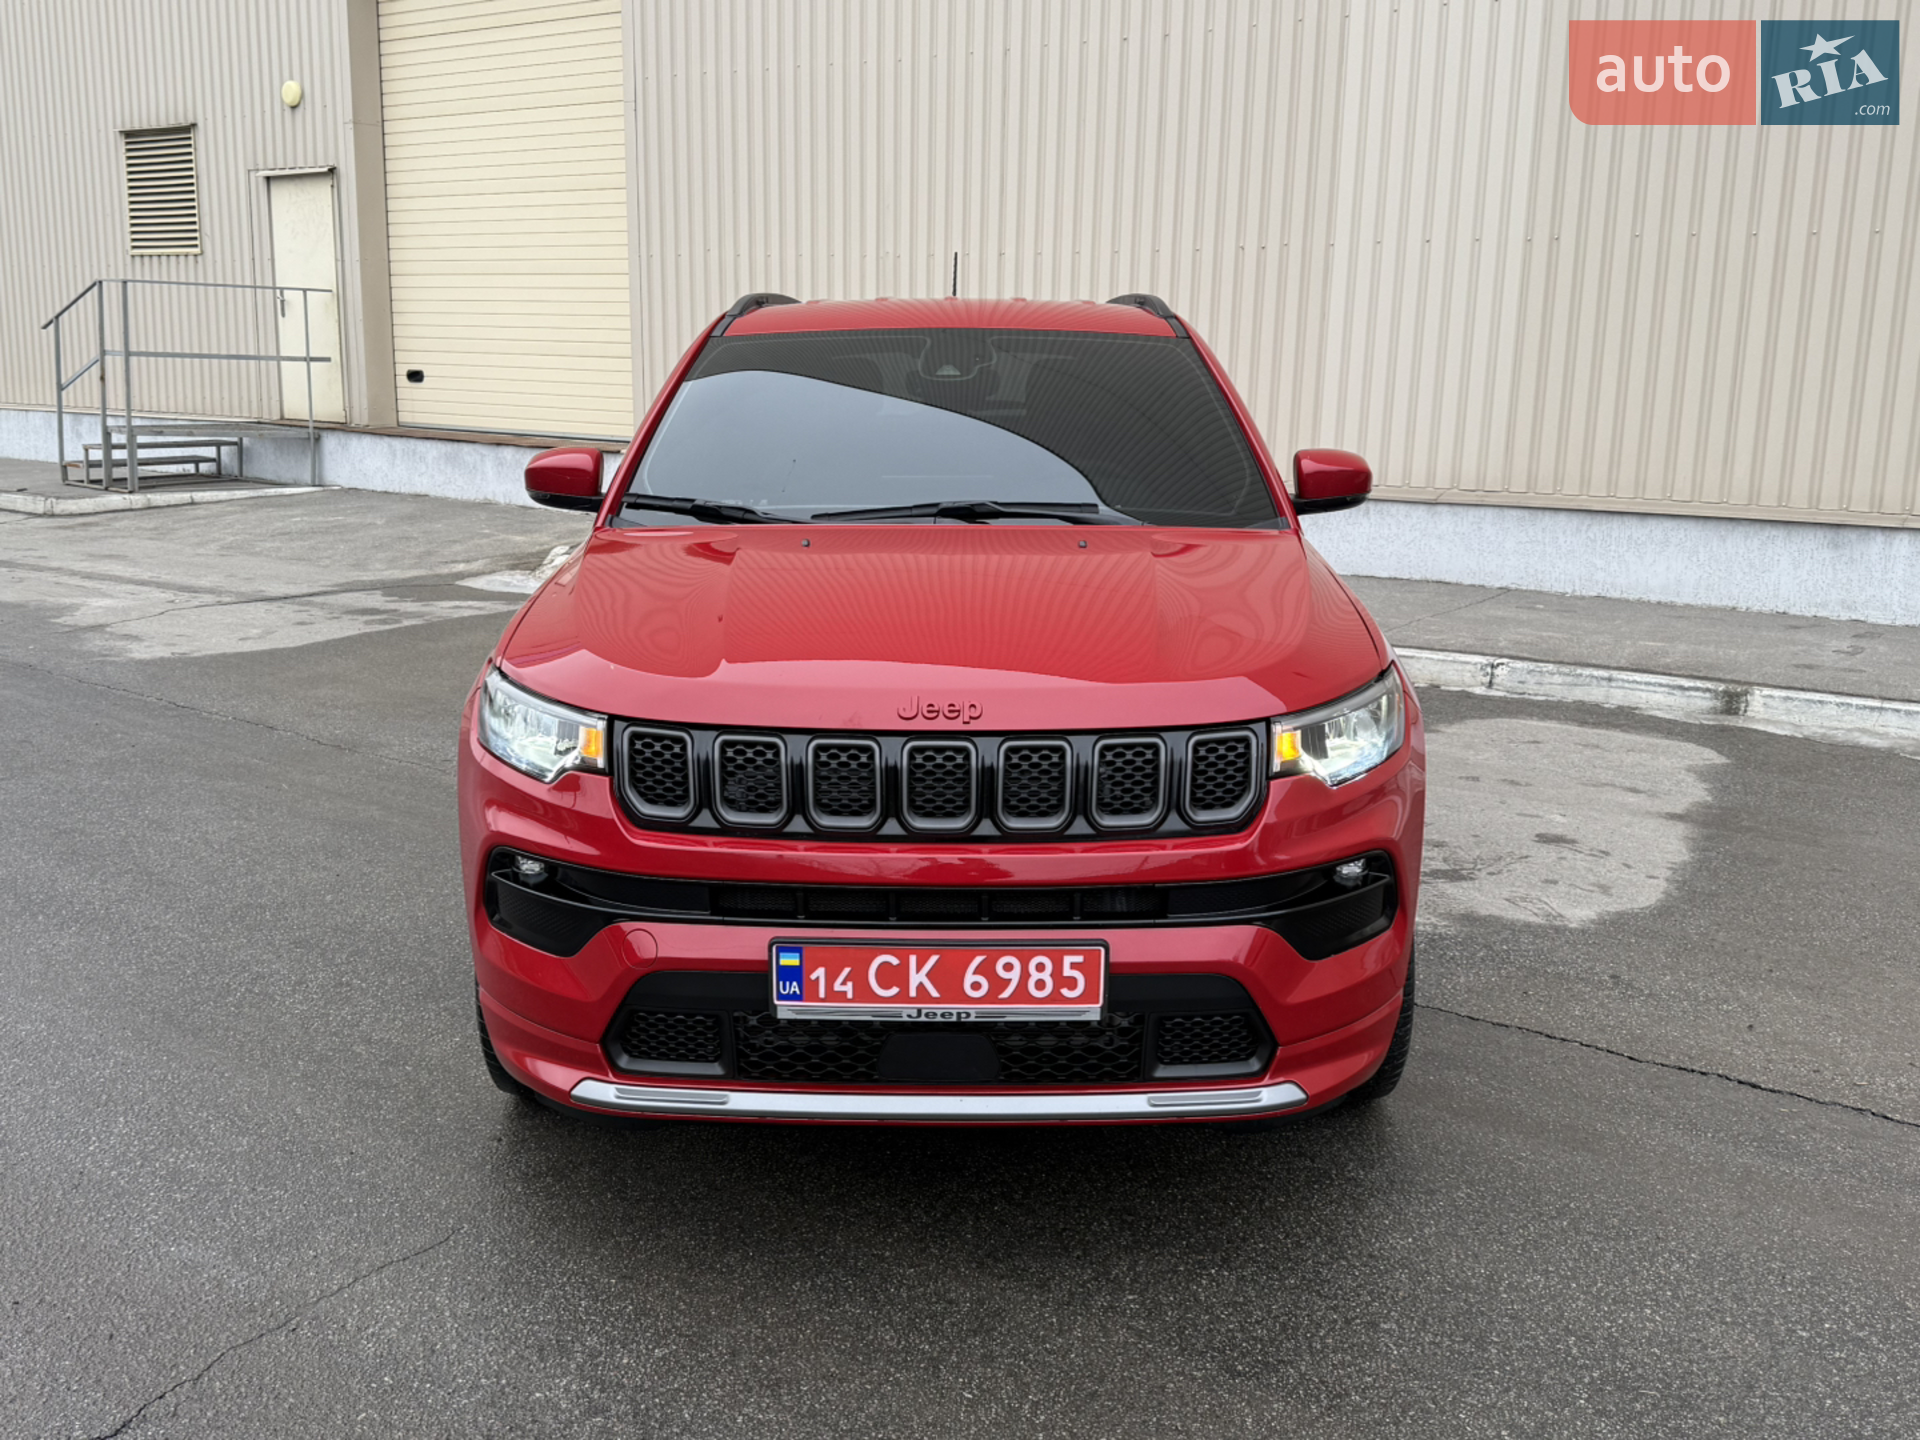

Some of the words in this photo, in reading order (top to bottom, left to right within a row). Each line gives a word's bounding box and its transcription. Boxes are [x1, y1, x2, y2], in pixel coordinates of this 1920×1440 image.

[896, 695, 983, 725] Jeep
[809, 966, 853, 999] 14
[867, 954, 941, 998] CK
[962, 954, 1086, 999] 6985
[779, 981, 800, 995] UA
[906, 1008, 972, 1021] Jeep
